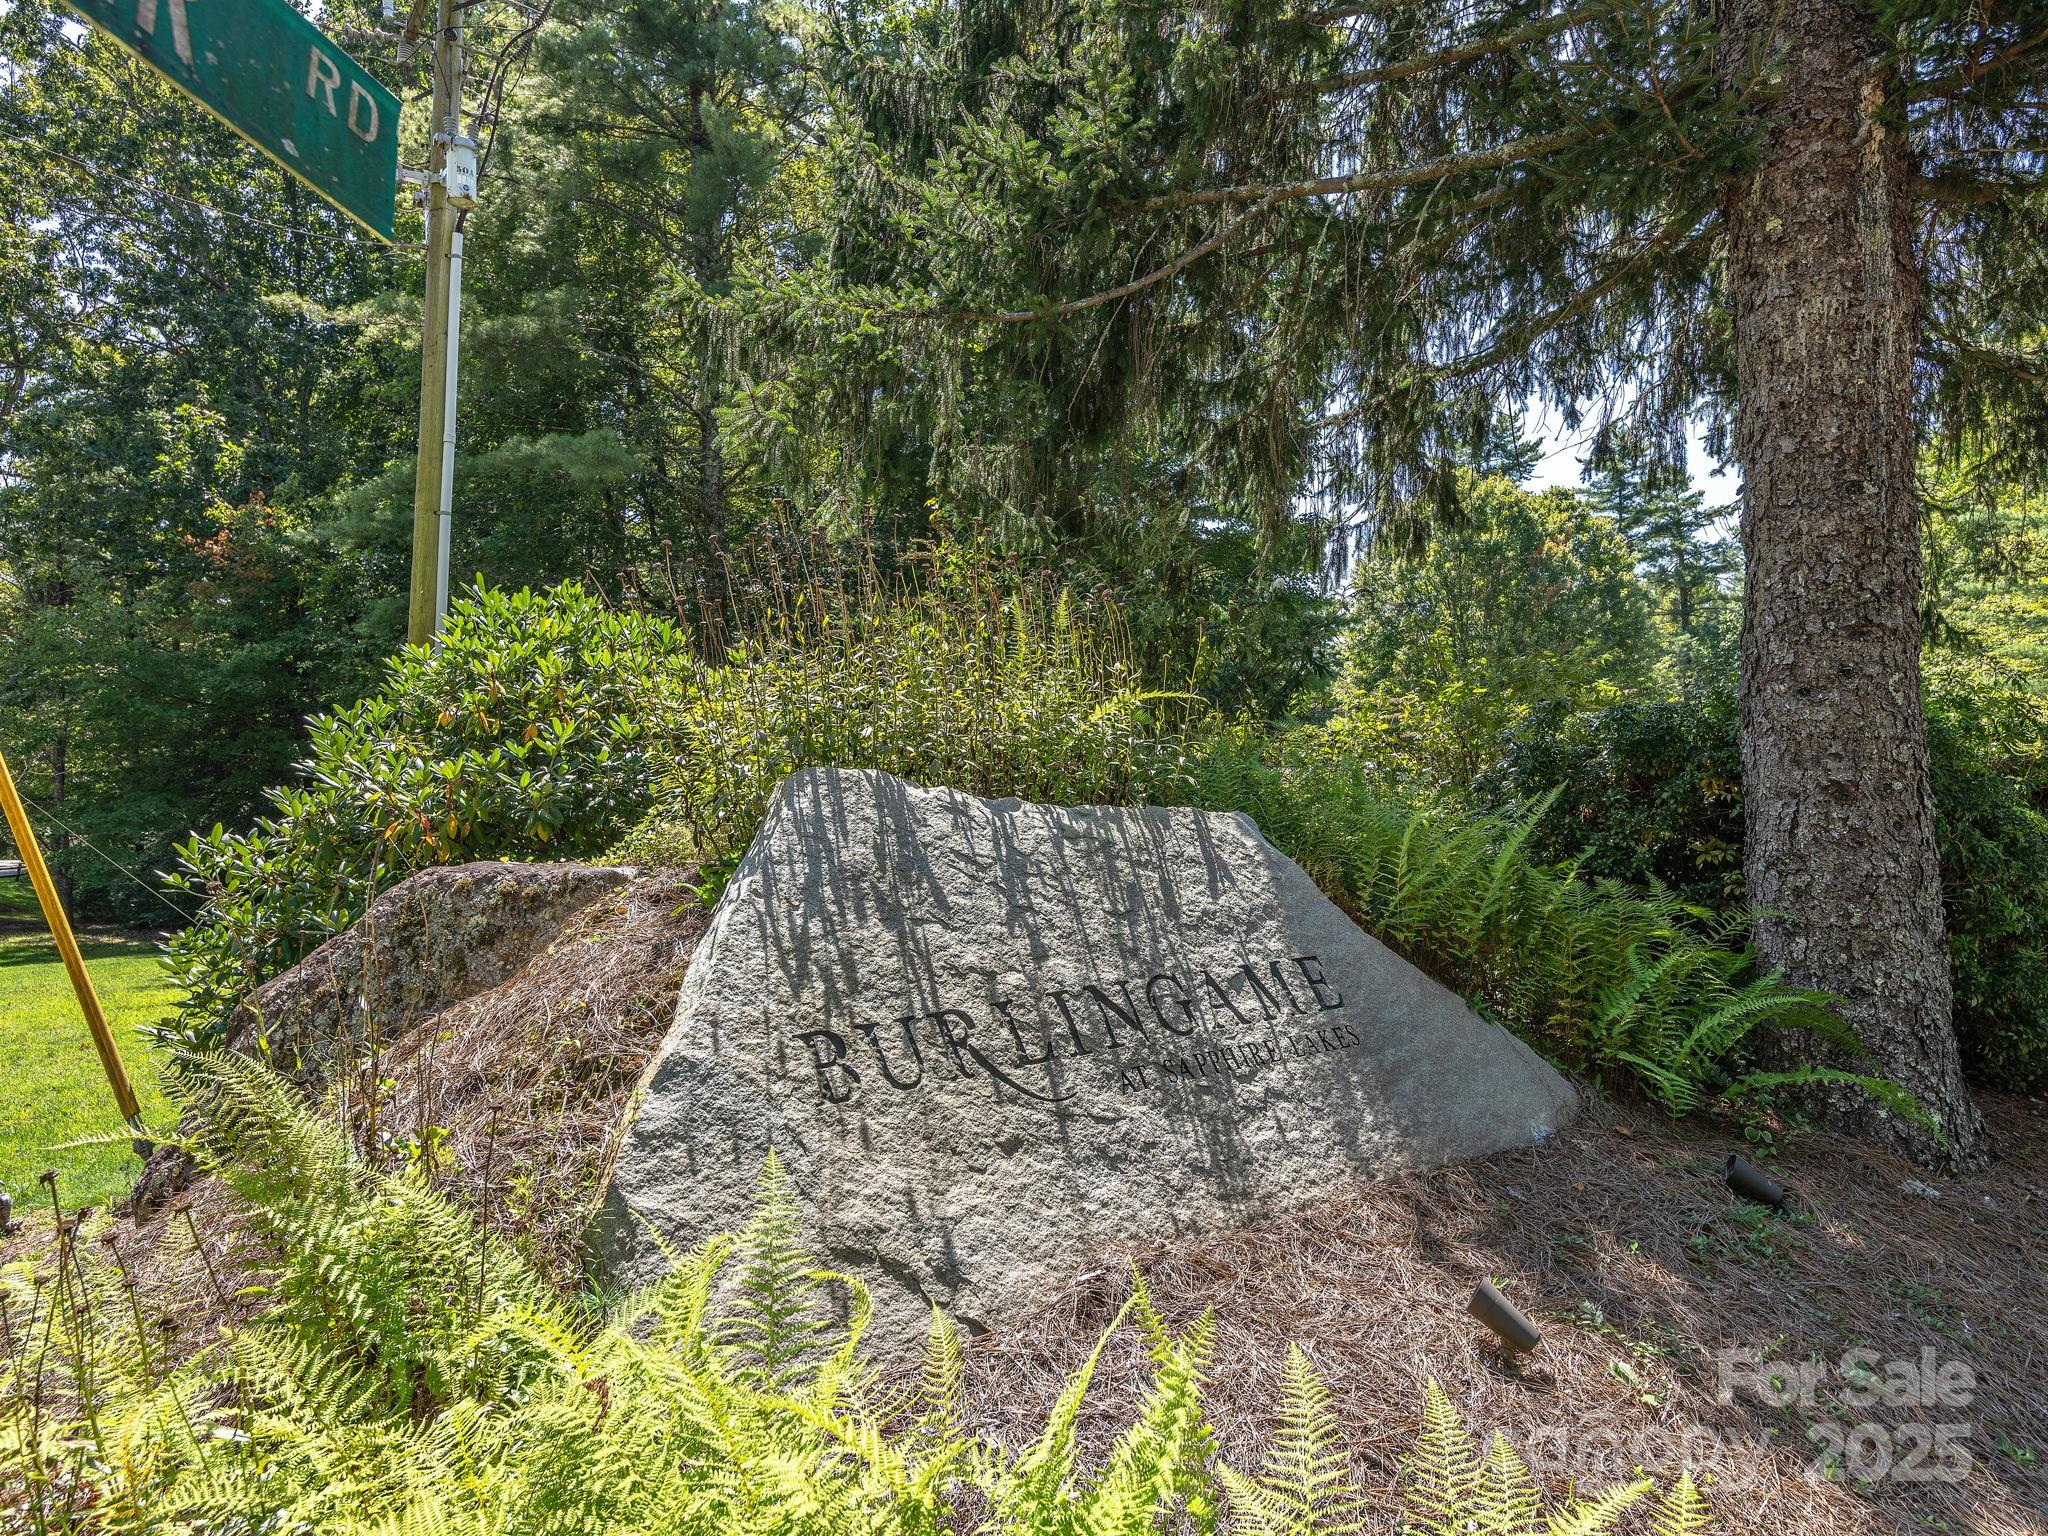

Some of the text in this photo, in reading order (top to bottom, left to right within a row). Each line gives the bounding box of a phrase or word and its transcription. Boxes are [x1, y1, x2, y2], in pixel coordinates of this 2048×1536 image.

[306, 45, 379, 142] RD
[792, 955, 1345, 1103] BURLINGAME
[1119, 1025, 1360, 1095] AT SAPPHIRE LAKES
